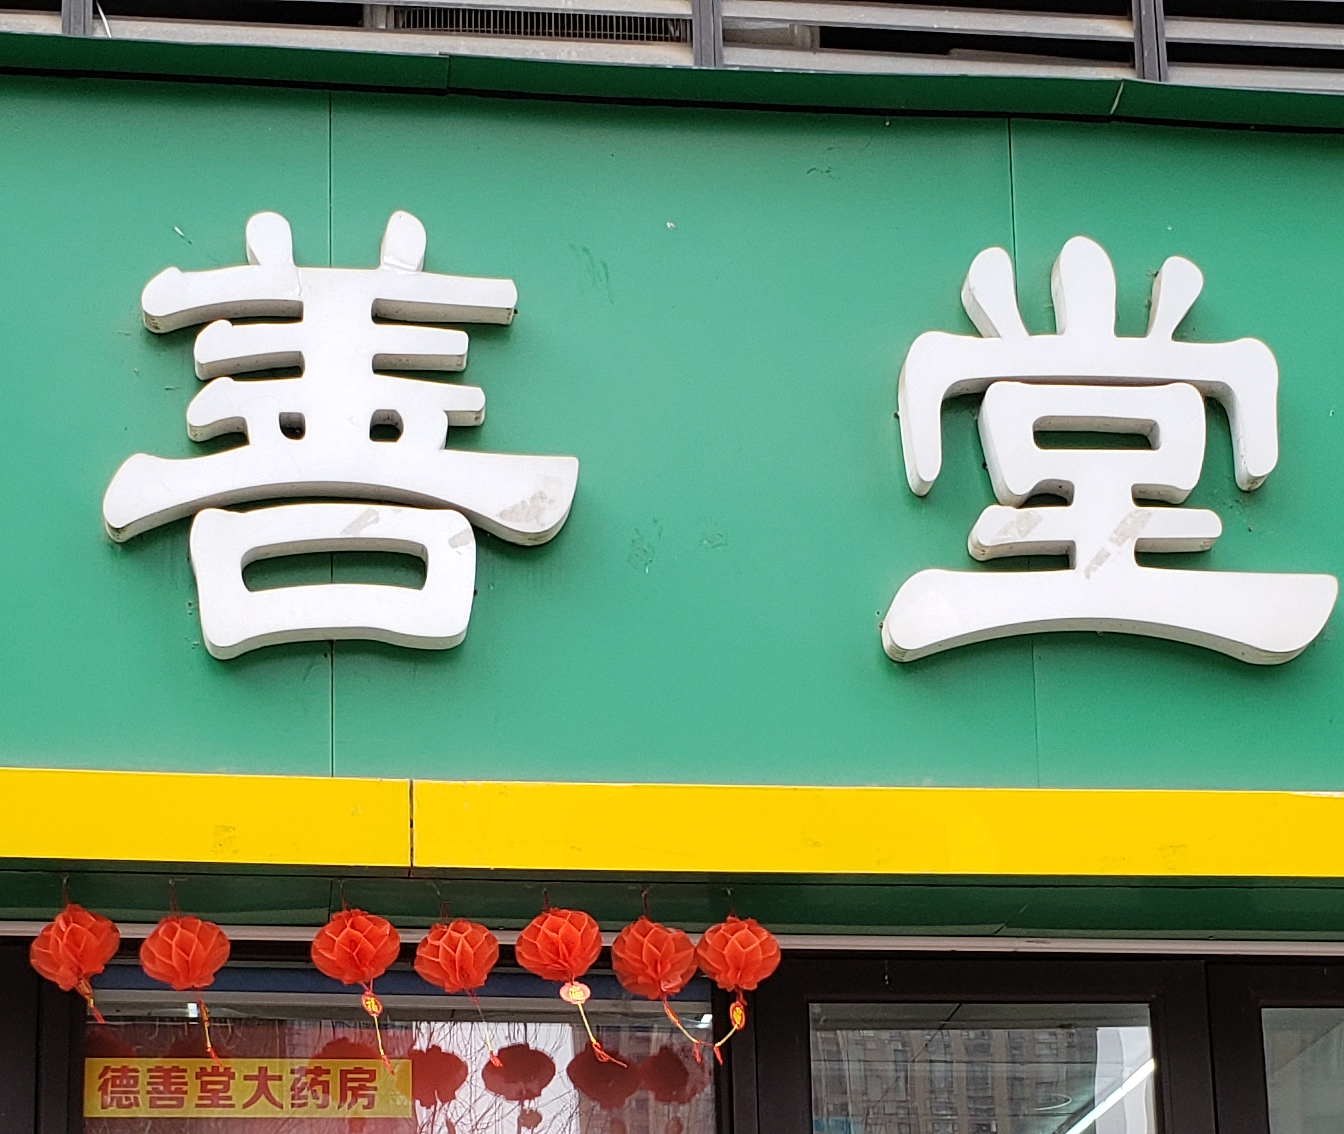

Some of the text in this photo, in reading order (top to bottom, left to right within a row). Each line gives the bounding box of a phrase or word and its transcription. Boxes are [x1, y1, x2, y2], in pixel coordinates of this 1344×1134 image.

[98, 1065, 378, 1110] 德善堂大药房
